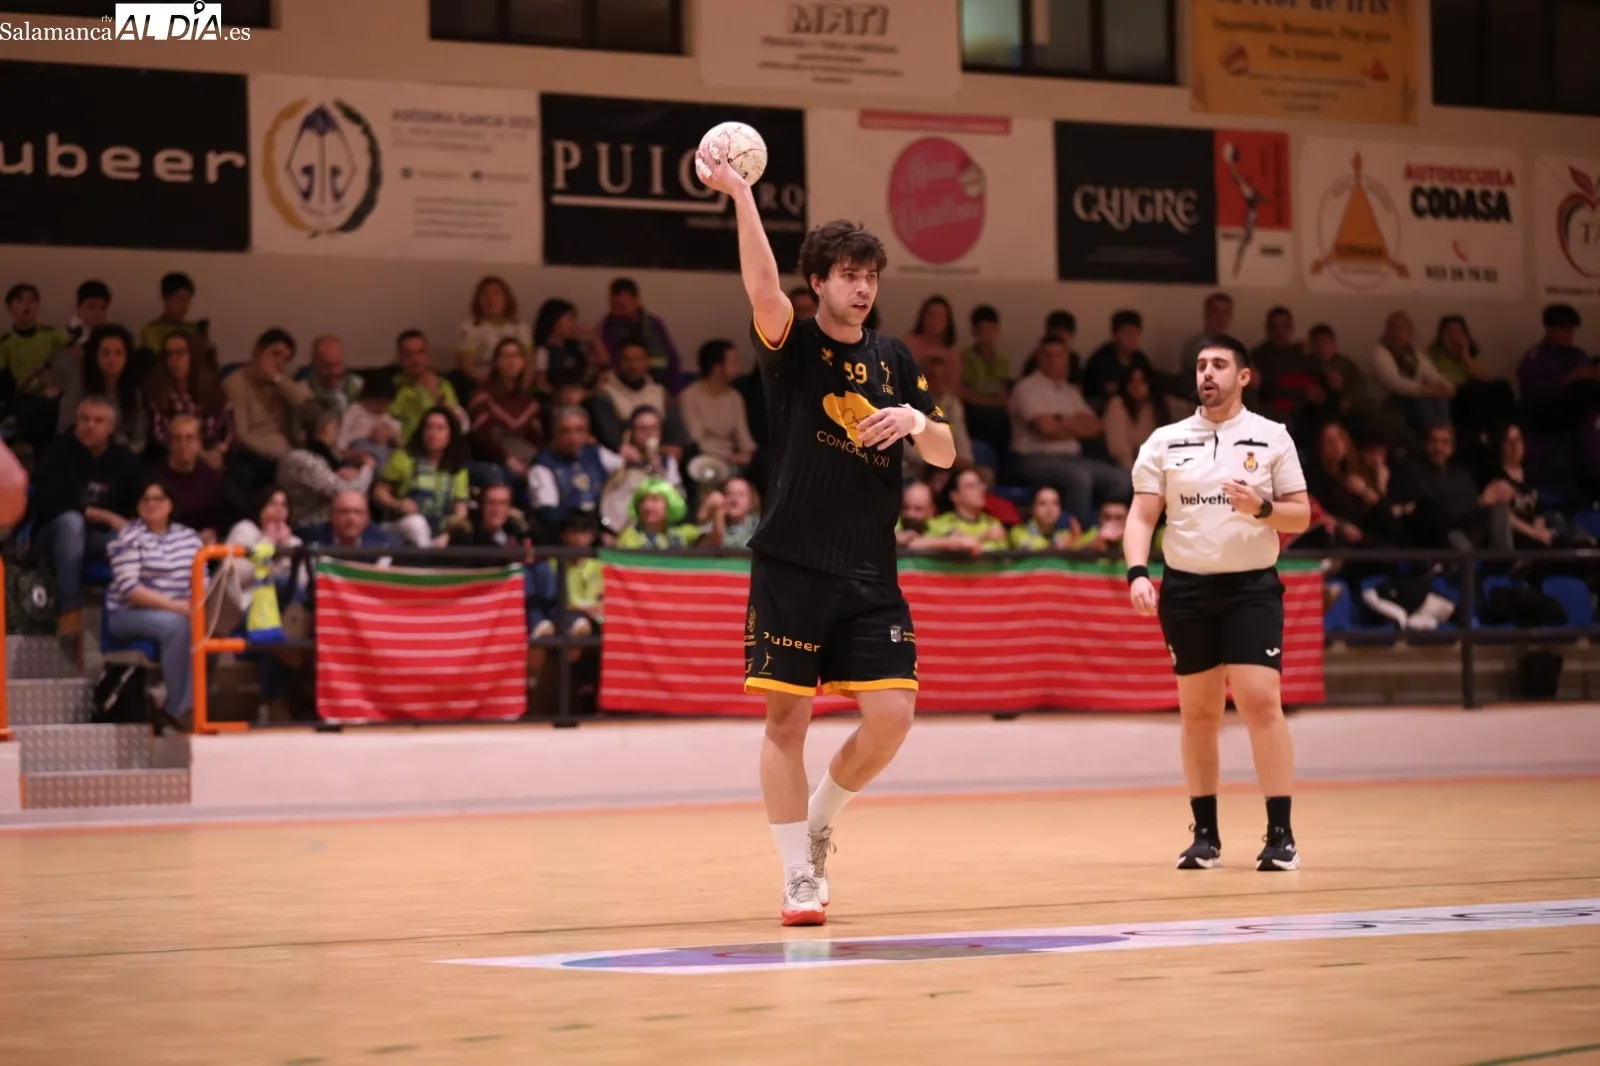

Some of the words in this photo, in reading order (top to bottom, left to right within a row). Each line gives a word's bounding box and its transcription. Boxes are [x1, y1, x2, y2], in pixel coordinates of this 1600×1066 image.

[757, 183, 805, 216] RQ
[1409, 185, 1513, 224] CODASA
[872, 453, 890, 468] XXI
